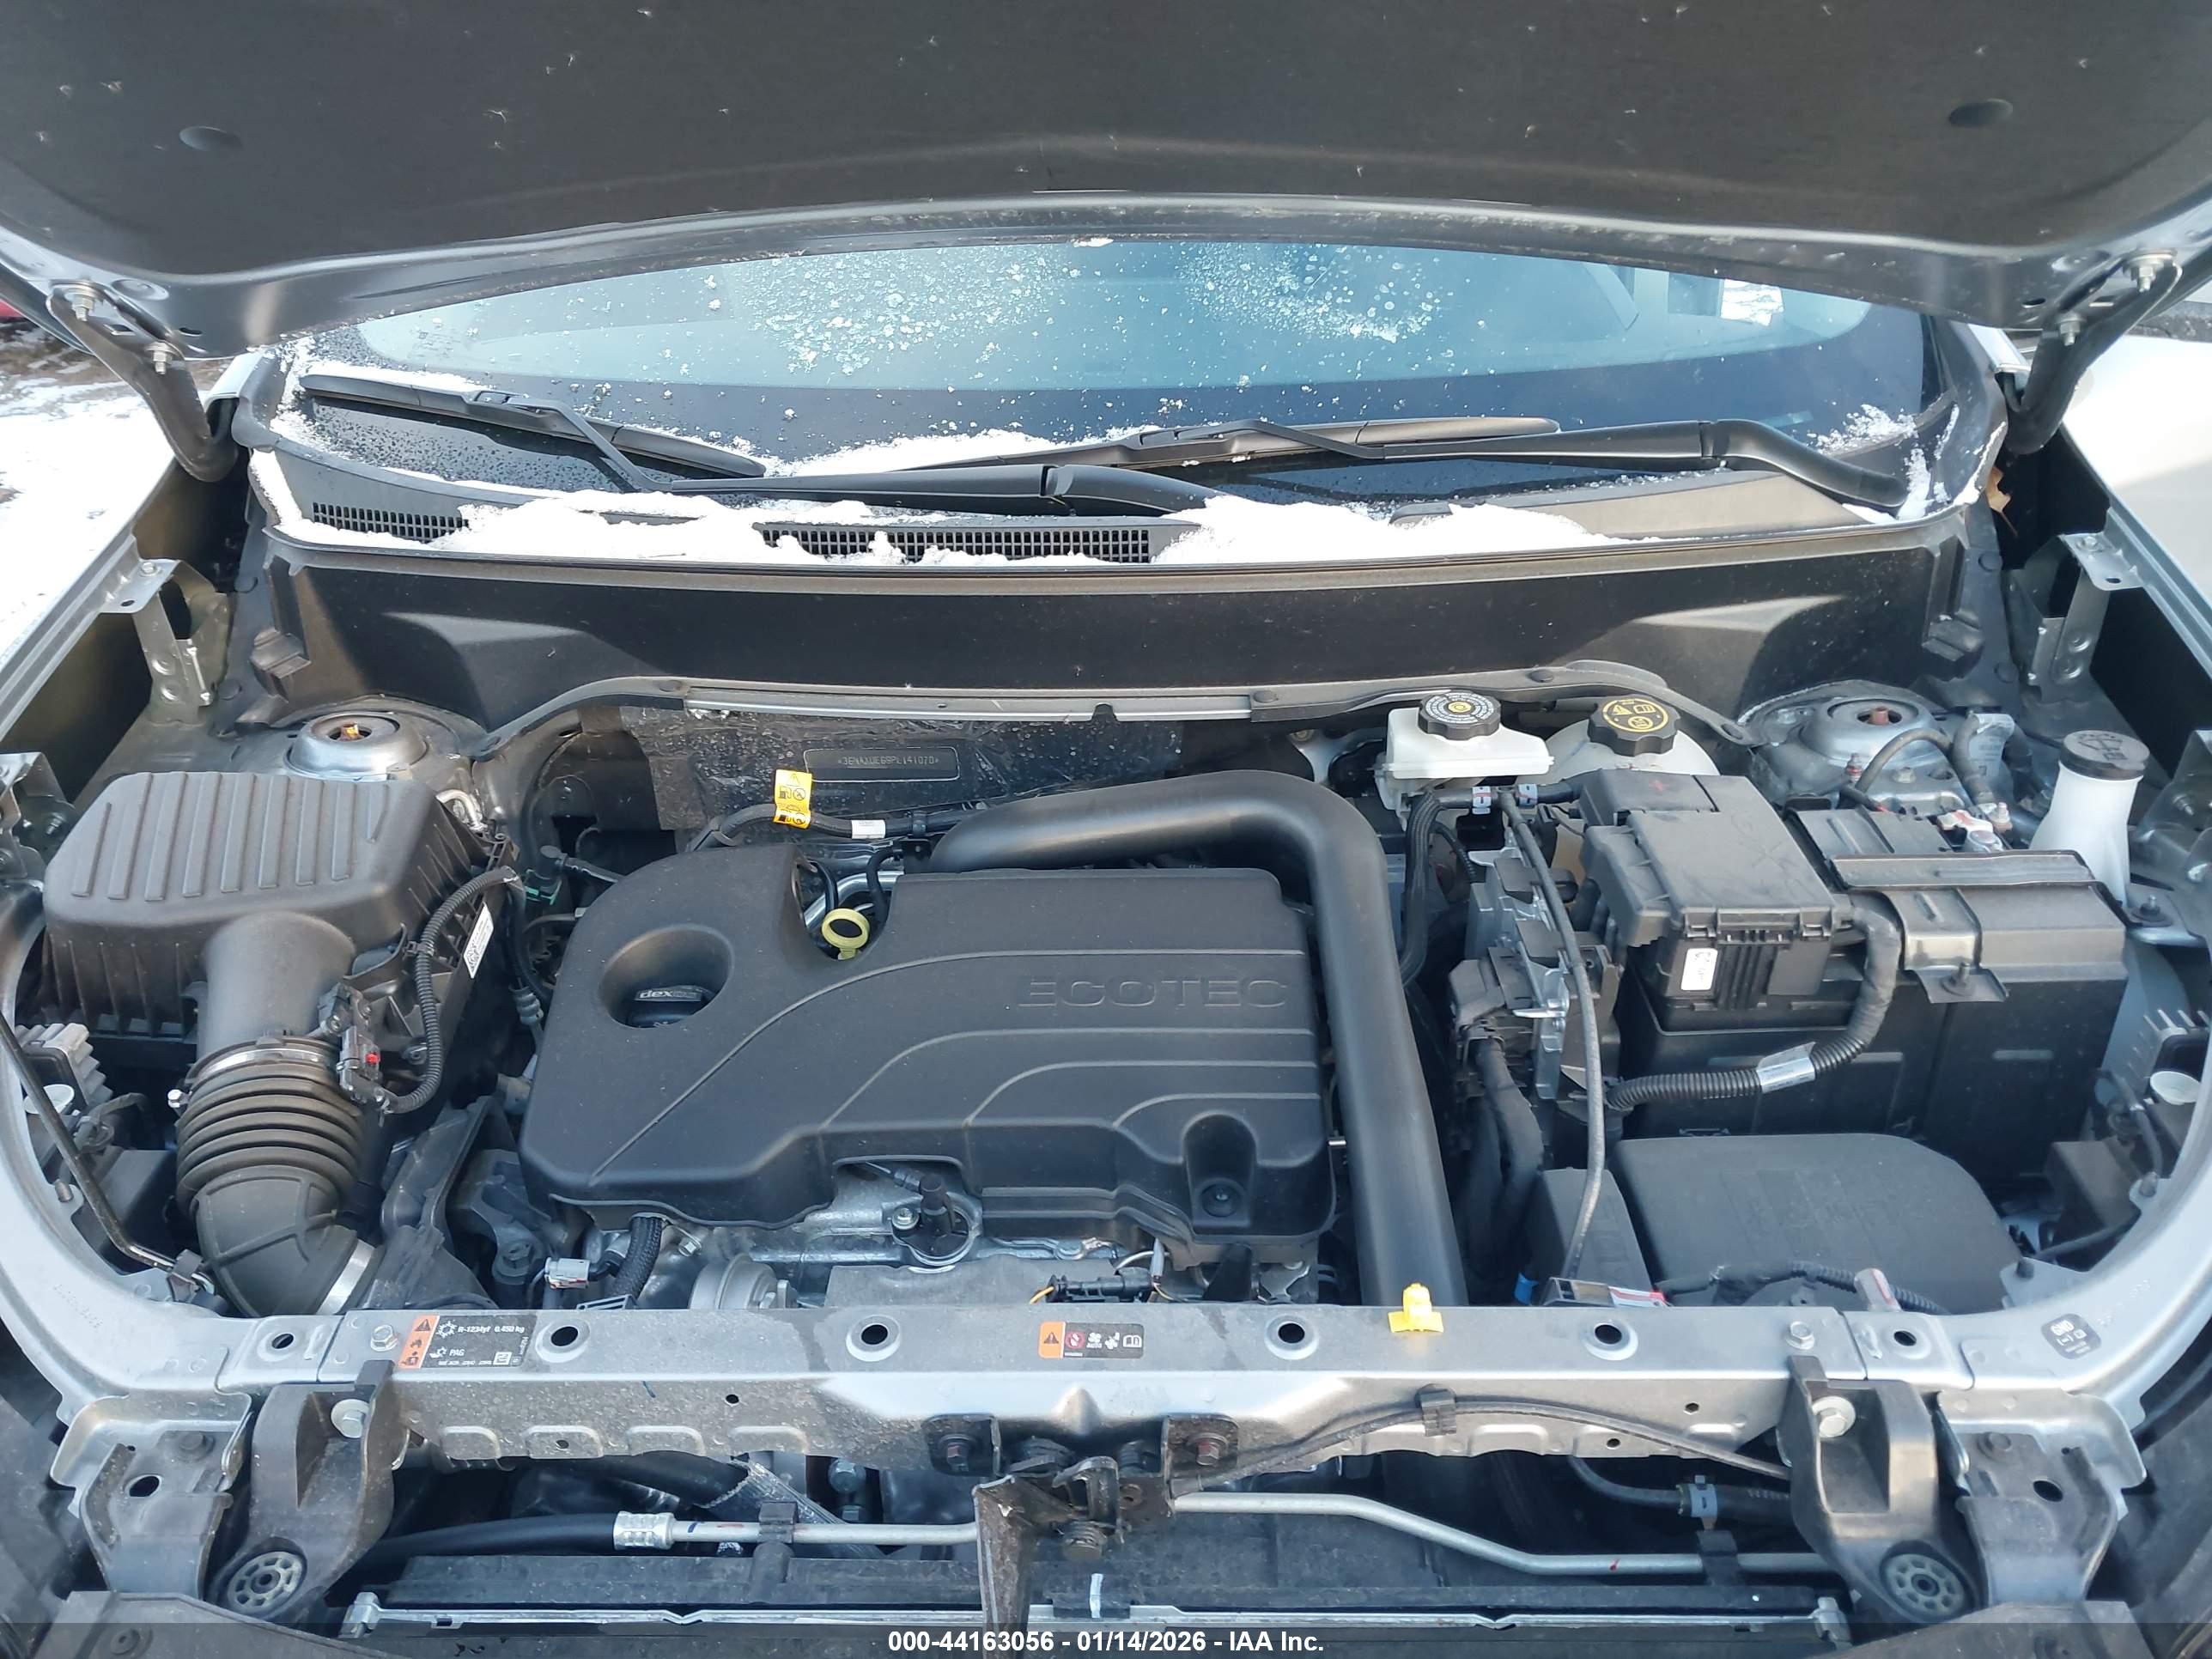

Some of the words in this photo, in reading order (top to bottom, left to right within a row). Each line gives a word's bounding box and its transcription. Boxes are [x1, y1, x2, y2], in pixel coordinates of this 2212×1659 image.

[1018, 981, 1287, 1007] ECOTEC
[457, 1325, 491, 1334] R-1234yf
[449, 1348, 465, 1357] PAG
